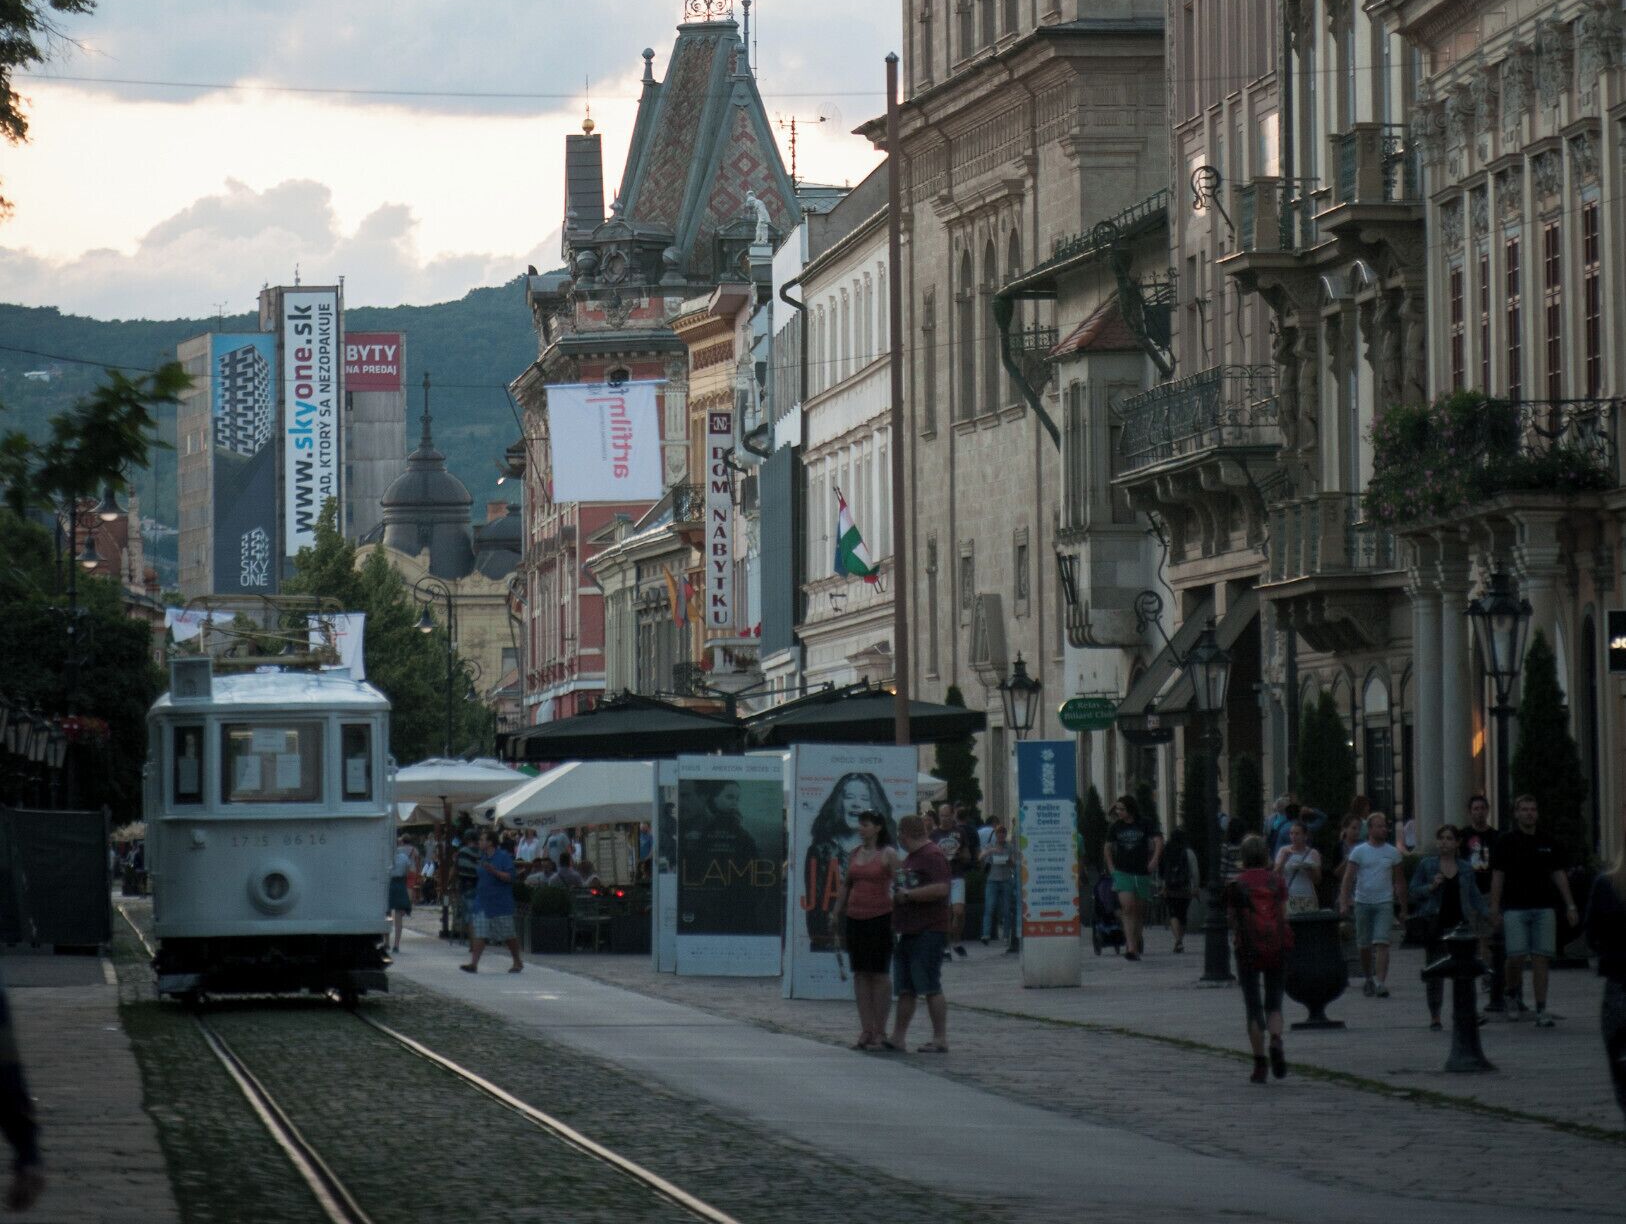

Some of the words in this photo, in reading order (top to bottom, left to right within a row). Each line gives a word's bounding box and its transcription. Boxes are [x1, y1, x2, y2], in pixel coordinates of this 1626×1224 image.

[318, 304, 333, 393] NEZOPAKUJE
[346, 344, 397, 362] BYTY
[345, 365, 360, 375] NA
[362, 365, 397, 376] PREDAJ
[287, 305, 318, 534] www.skyone.sk
[319, 399, 332, 418] SA
[316, 422, 332, 468] KTORÝ
[711, 447, 729, 494] DOM
[240, 574, 268, 586] ONE
[241, 560, 269, 574] SKY
[712, 509, 729, 624] NÁBYTKU
[682, 858, 777, 887] LAMB
